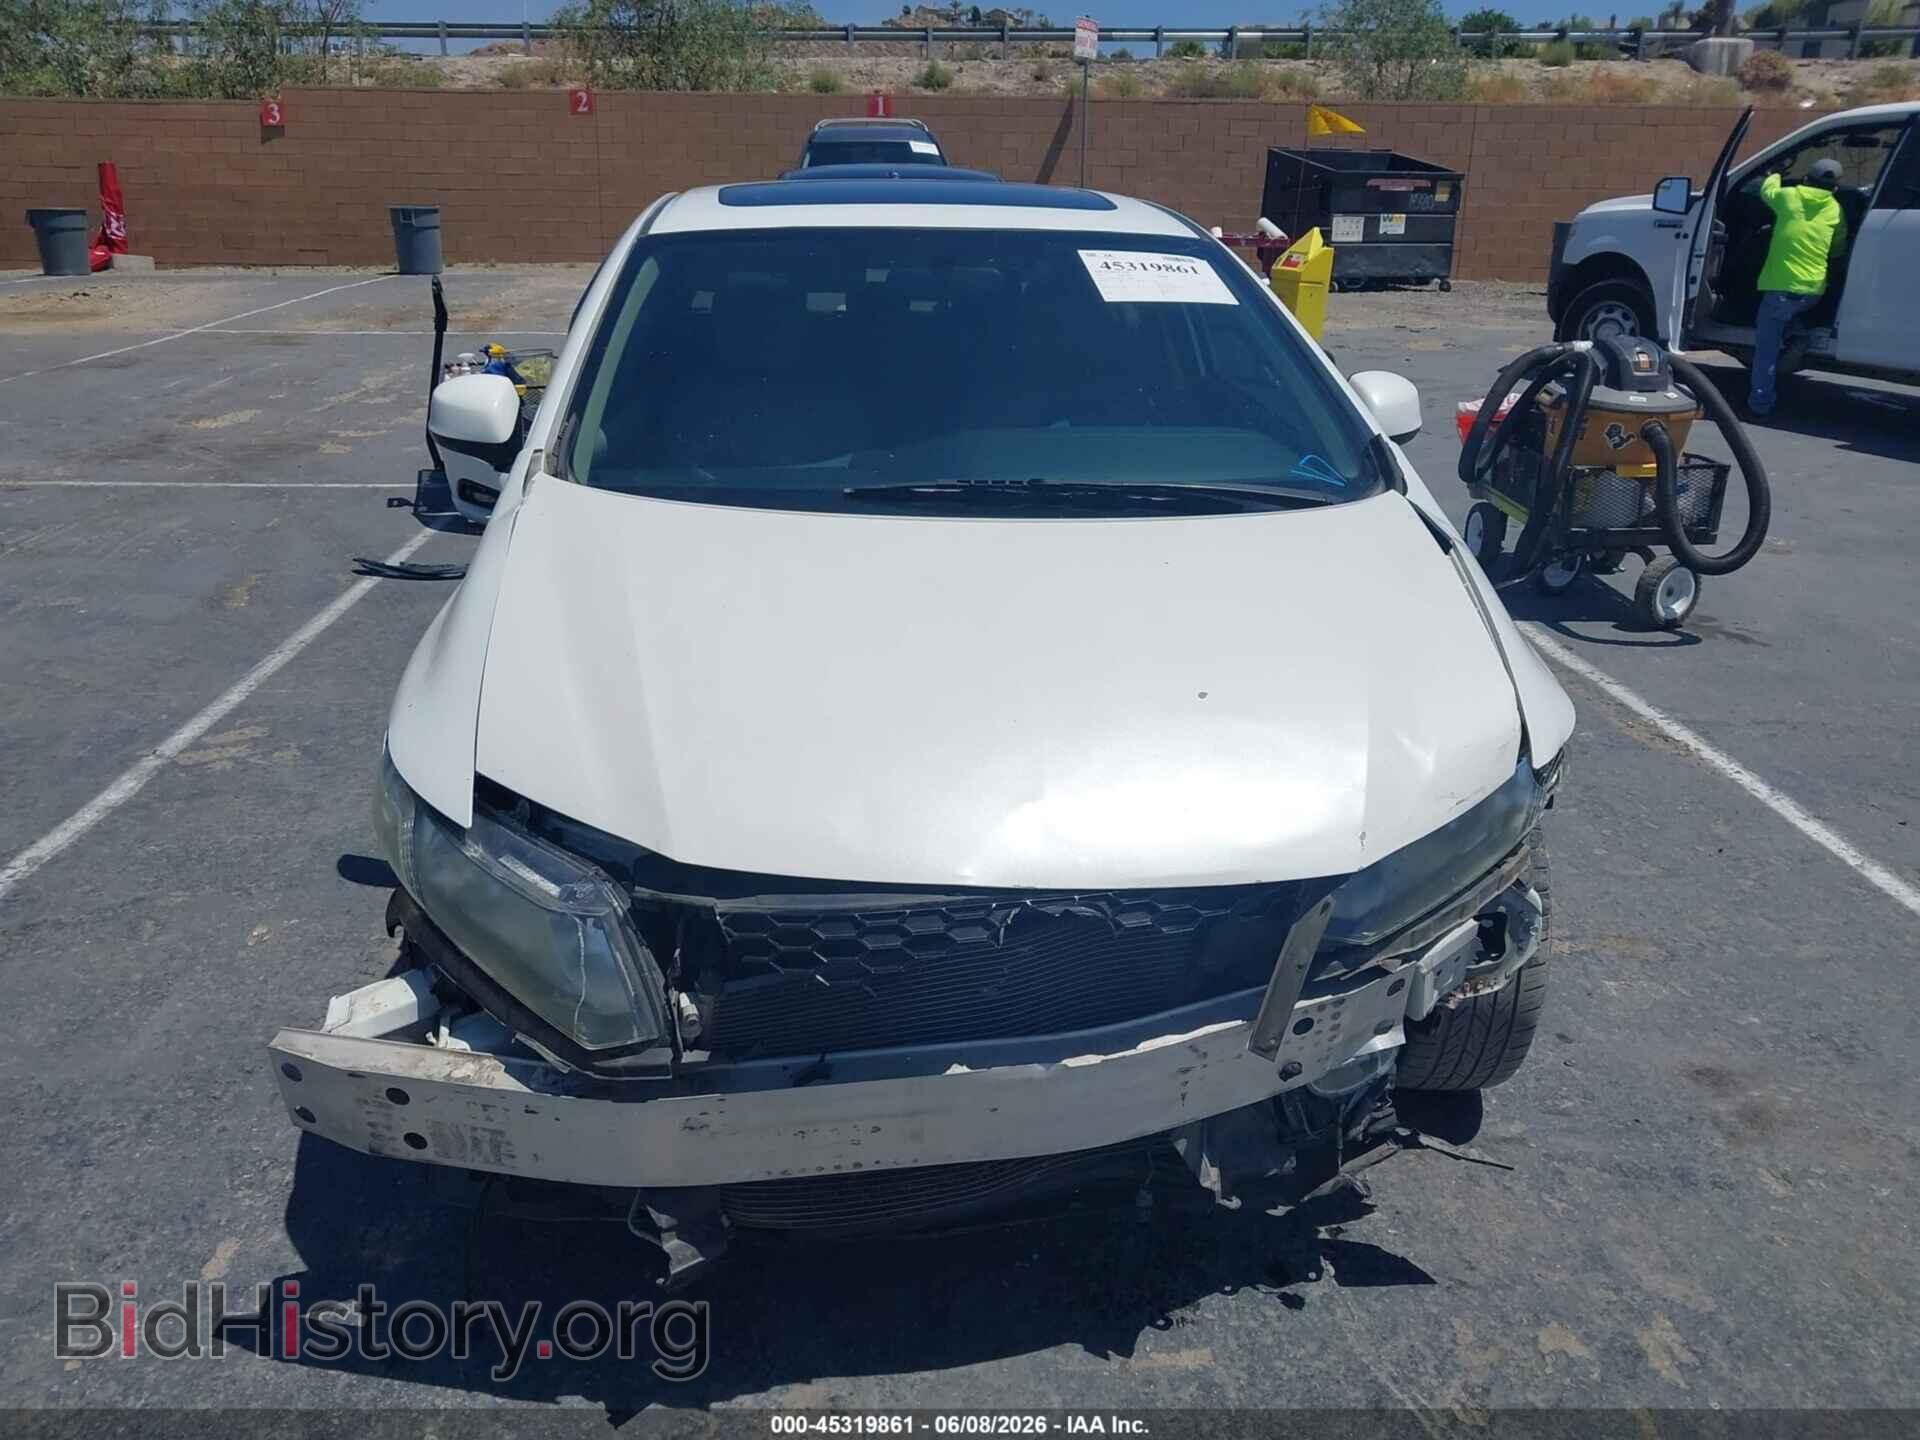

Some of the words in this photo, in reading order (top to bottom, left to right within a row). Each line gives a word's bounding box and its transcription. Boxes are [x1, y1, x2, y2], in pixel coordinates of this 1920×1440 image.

[576, 91, 588, 112] 2
[876, 95, 886, 116] 1
[267, 103, 280, 125] 3
[1100, 260, 1200, 275] 45319861
